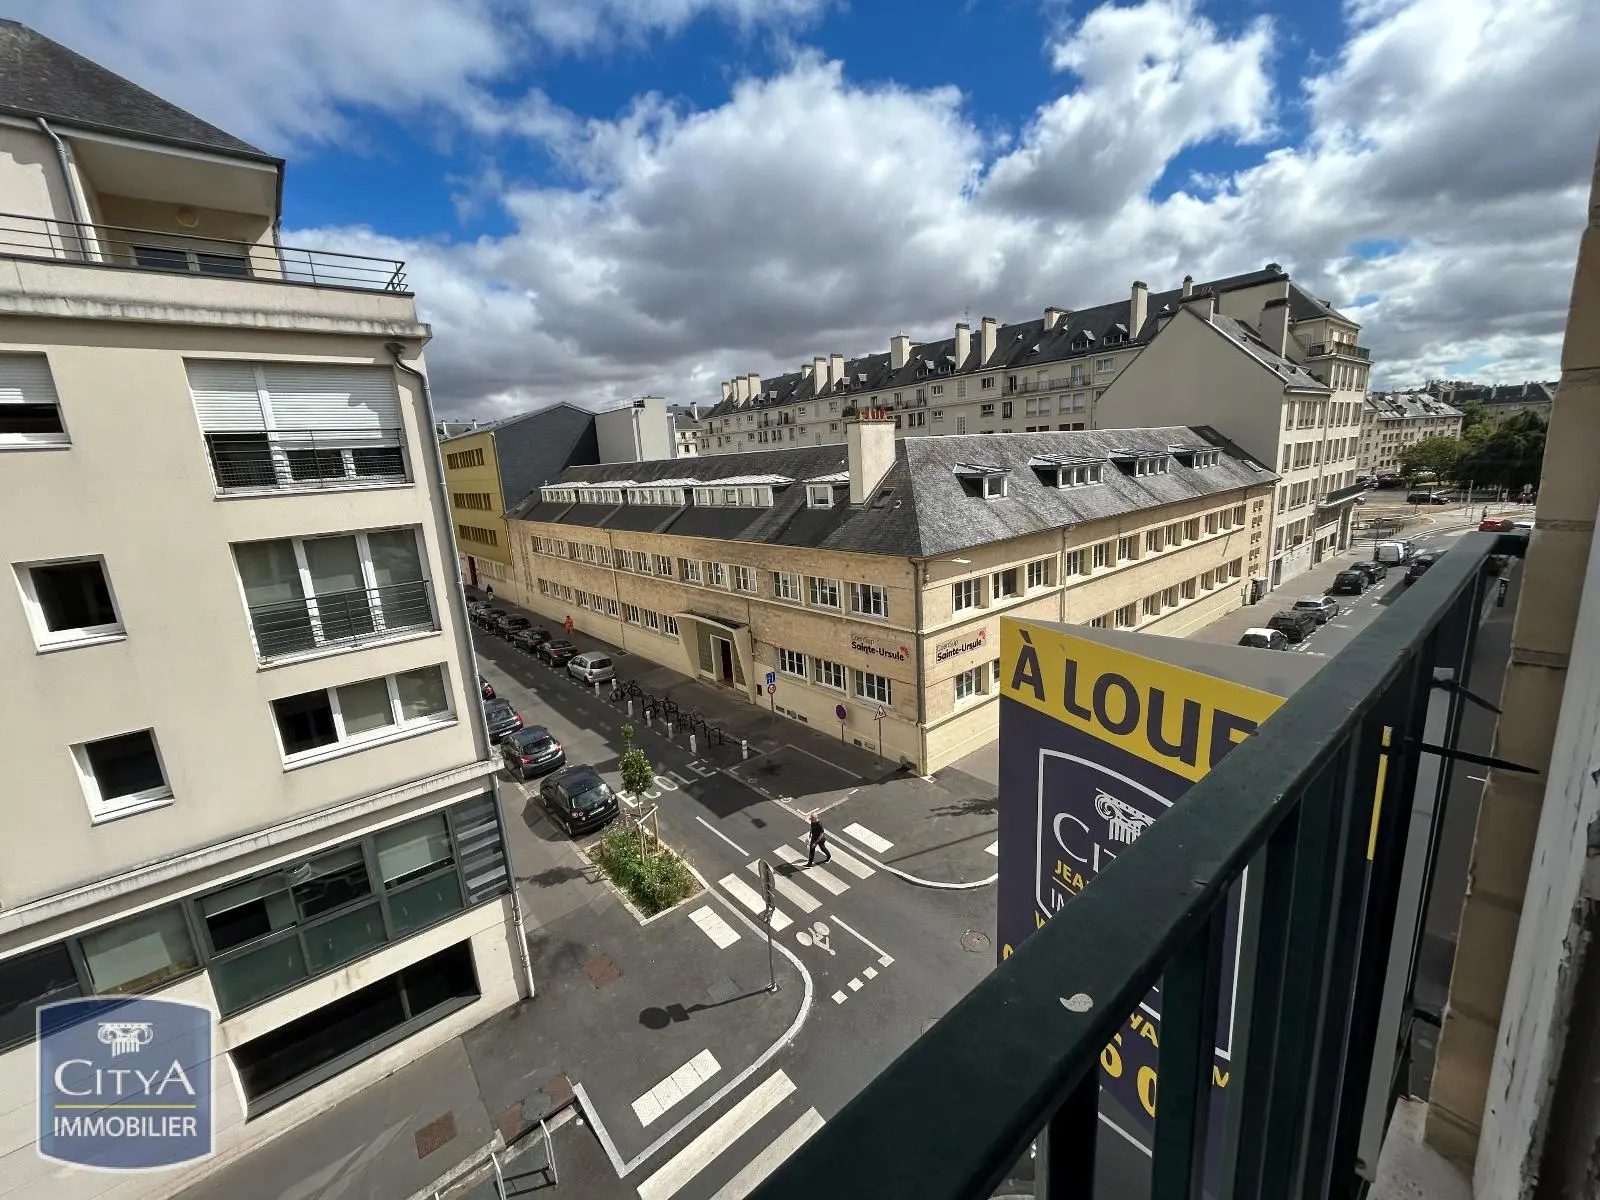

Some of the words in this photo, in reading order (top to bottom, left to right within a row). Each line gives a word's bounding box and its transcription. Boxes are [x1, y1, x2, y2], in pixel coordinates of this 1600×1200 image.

[852, 641, 905, 661] Sainte-Ursule
[937, 638, 982, 661] Sainte-Ursule
[1011, 628, 1046, 702] À
[1064, 658, 1259, 770] LOUE
[1054, 859, 1090, 891] JEA
